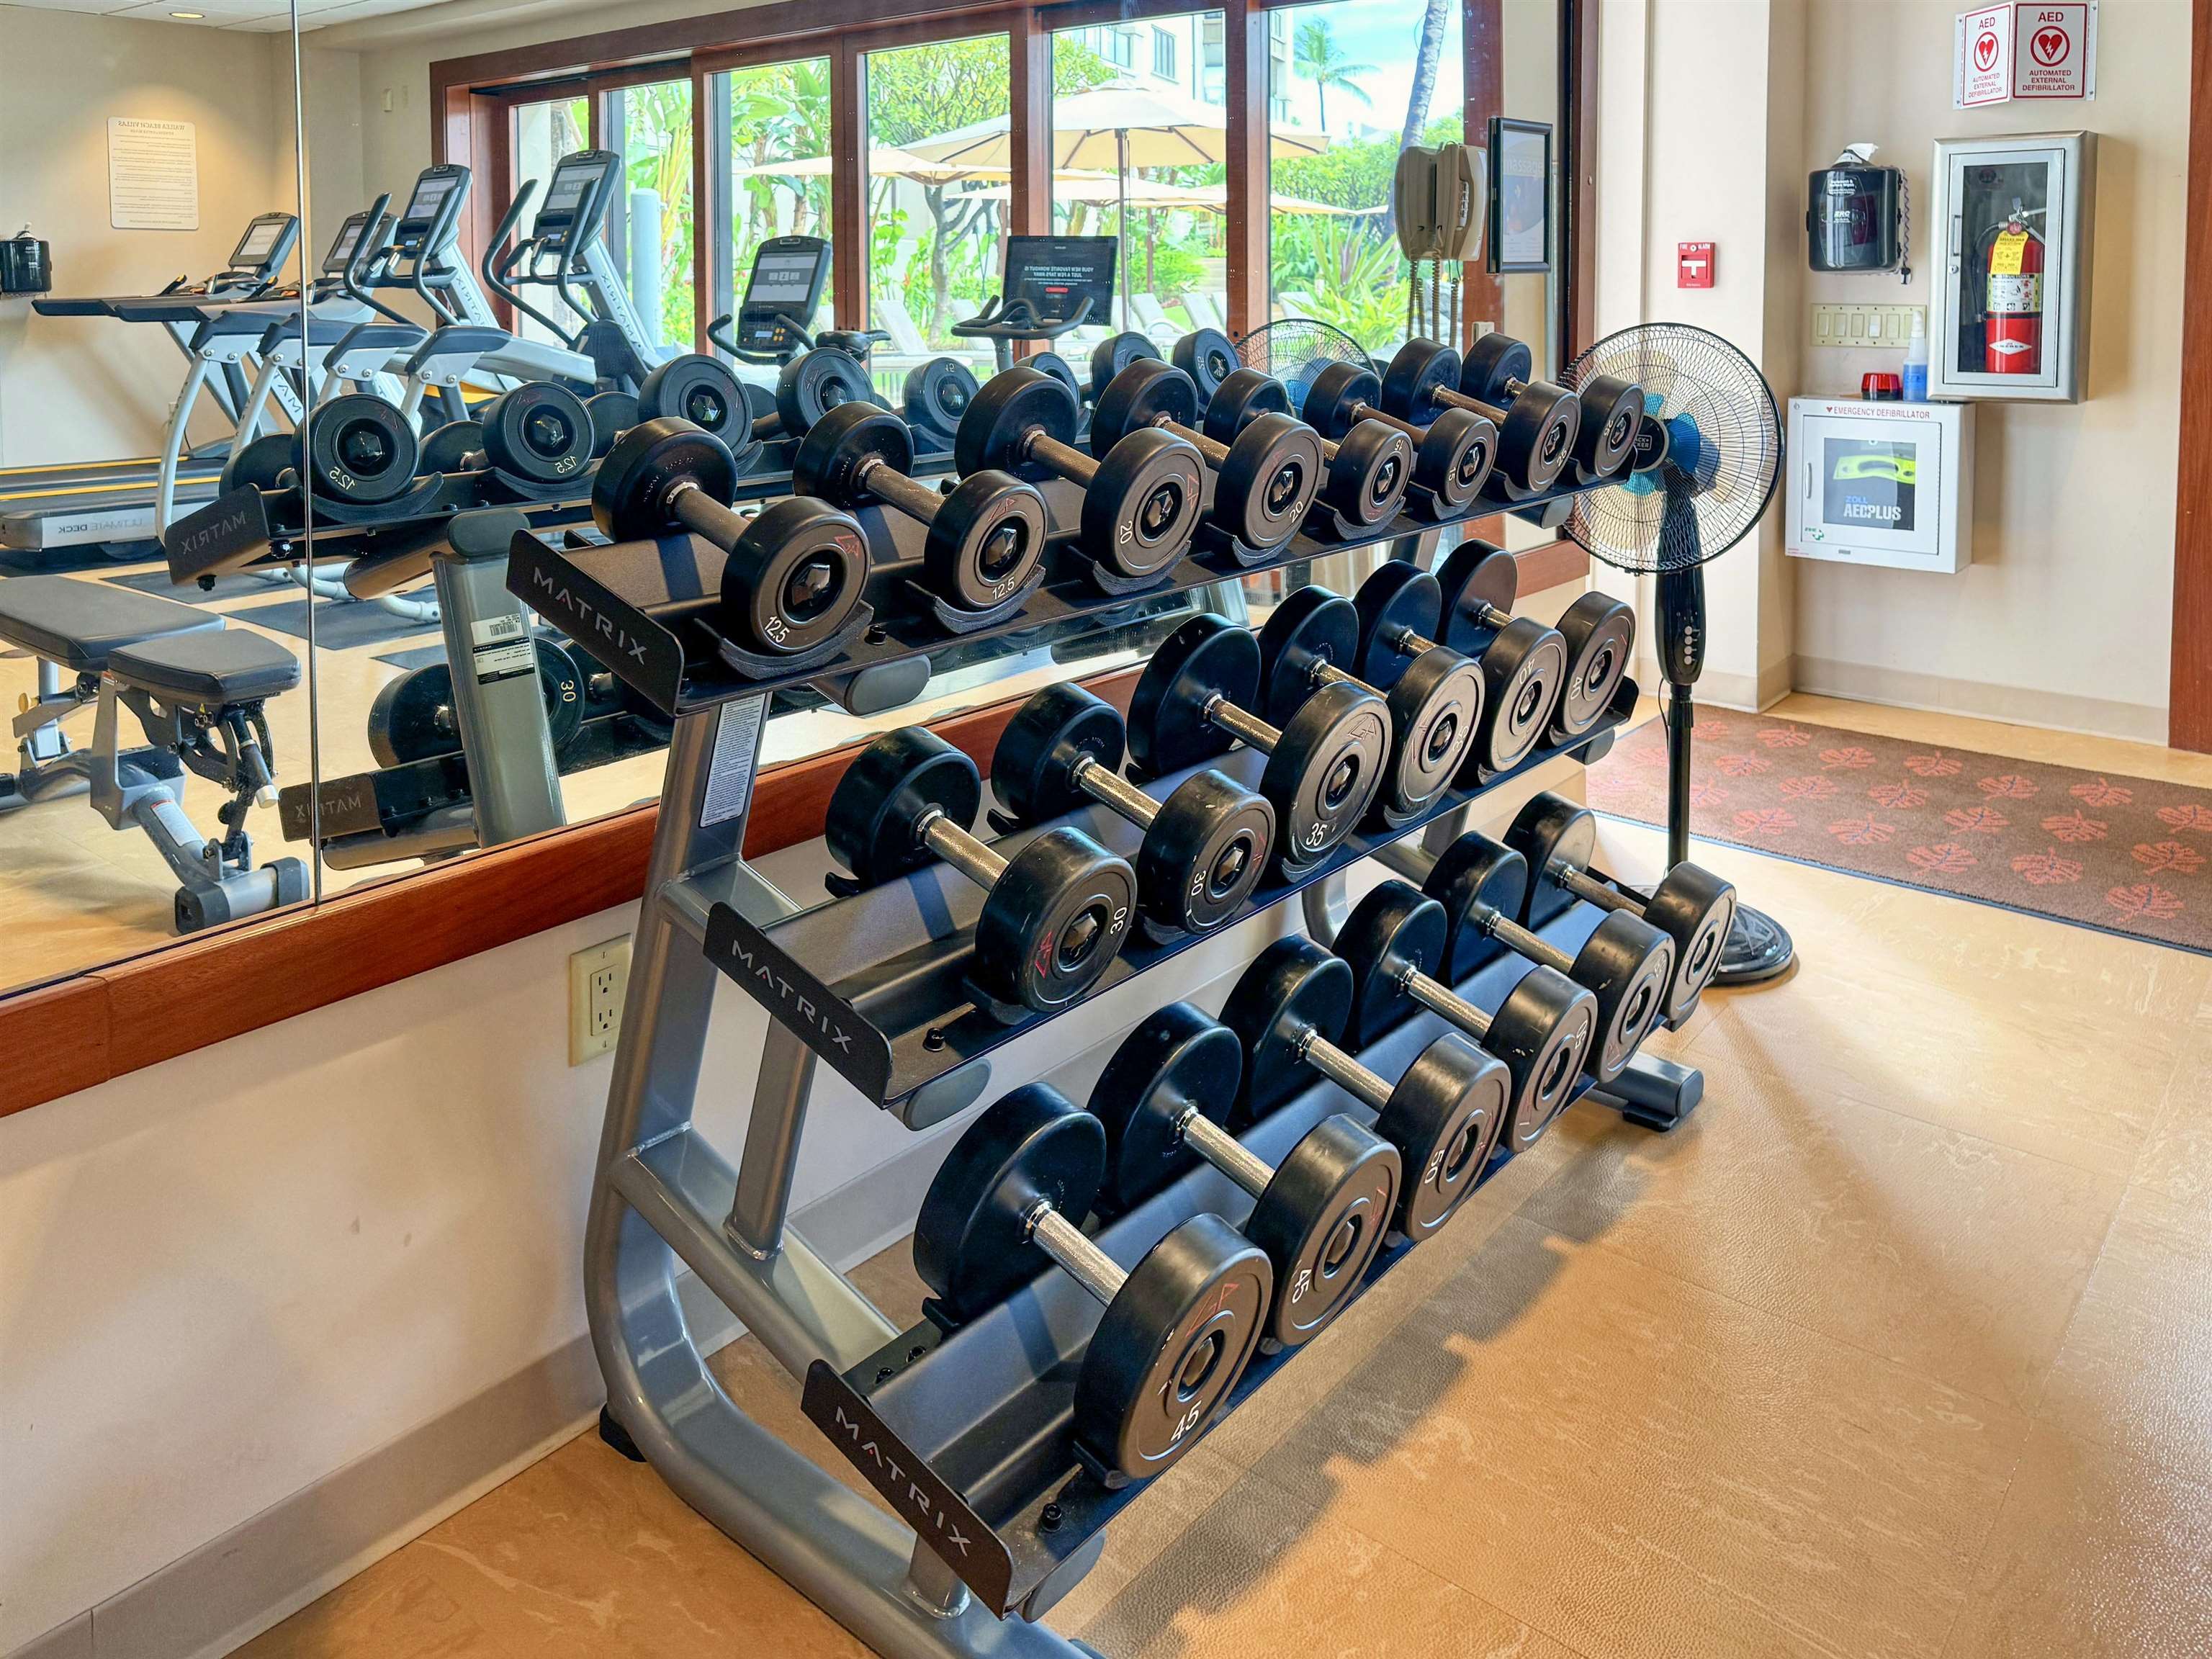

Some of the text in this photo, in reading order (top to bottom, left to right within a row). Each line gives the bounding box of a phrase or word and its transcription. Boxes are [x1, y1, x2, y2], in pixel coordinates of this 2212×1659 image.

[1979, 17, 1995, 30] AED
[2038, 12, 2064, 22] AED
[1972, 73, 2000, 83] AUTOMATED
[1973, 81, 1996, 90] EXTERNAL
[1968, 86, 2002, 98] DEFIBRILLATOR
[1833, 406, 1930, 419] EMERGENCY DEFIBRILLATOR
[1604, 420, 1614, 436] 25
[1395, 439, 1403, 451] 15
[1557, 448, 1568, 467] 25
[1448, 467, 1457, 481] 15
[1289, 500, 1304, 523] 20
[1845, 495, 1868, 504] ZOLL
[1120, 520, 1133, 545] 20
[992, 576, 1015, 601] 12.5
[532, 565, 648, 666] MATRIX
[764, 616, 791, 644] 12.5
[1519, 658, 1535, 685] 40
[1570, 676, 1583, 701] 40
[1452, 725, 1470, 753] 35
[1305, 822, 1328, 847] 35
[1191, 870, 1207, 896] 30
[1110, 906, 1128, 935] 30
[732, 939, 853, 1055] MATRIX
[1575, 1020, 1588, 1050] 50
[1424, 1149, 1445, 1184] 50
[1292, 1269, 1312, 1303] 45
[1170, 1400, 1202, 1442] 45
[835, 1406, 971, 1557] MATRIX
